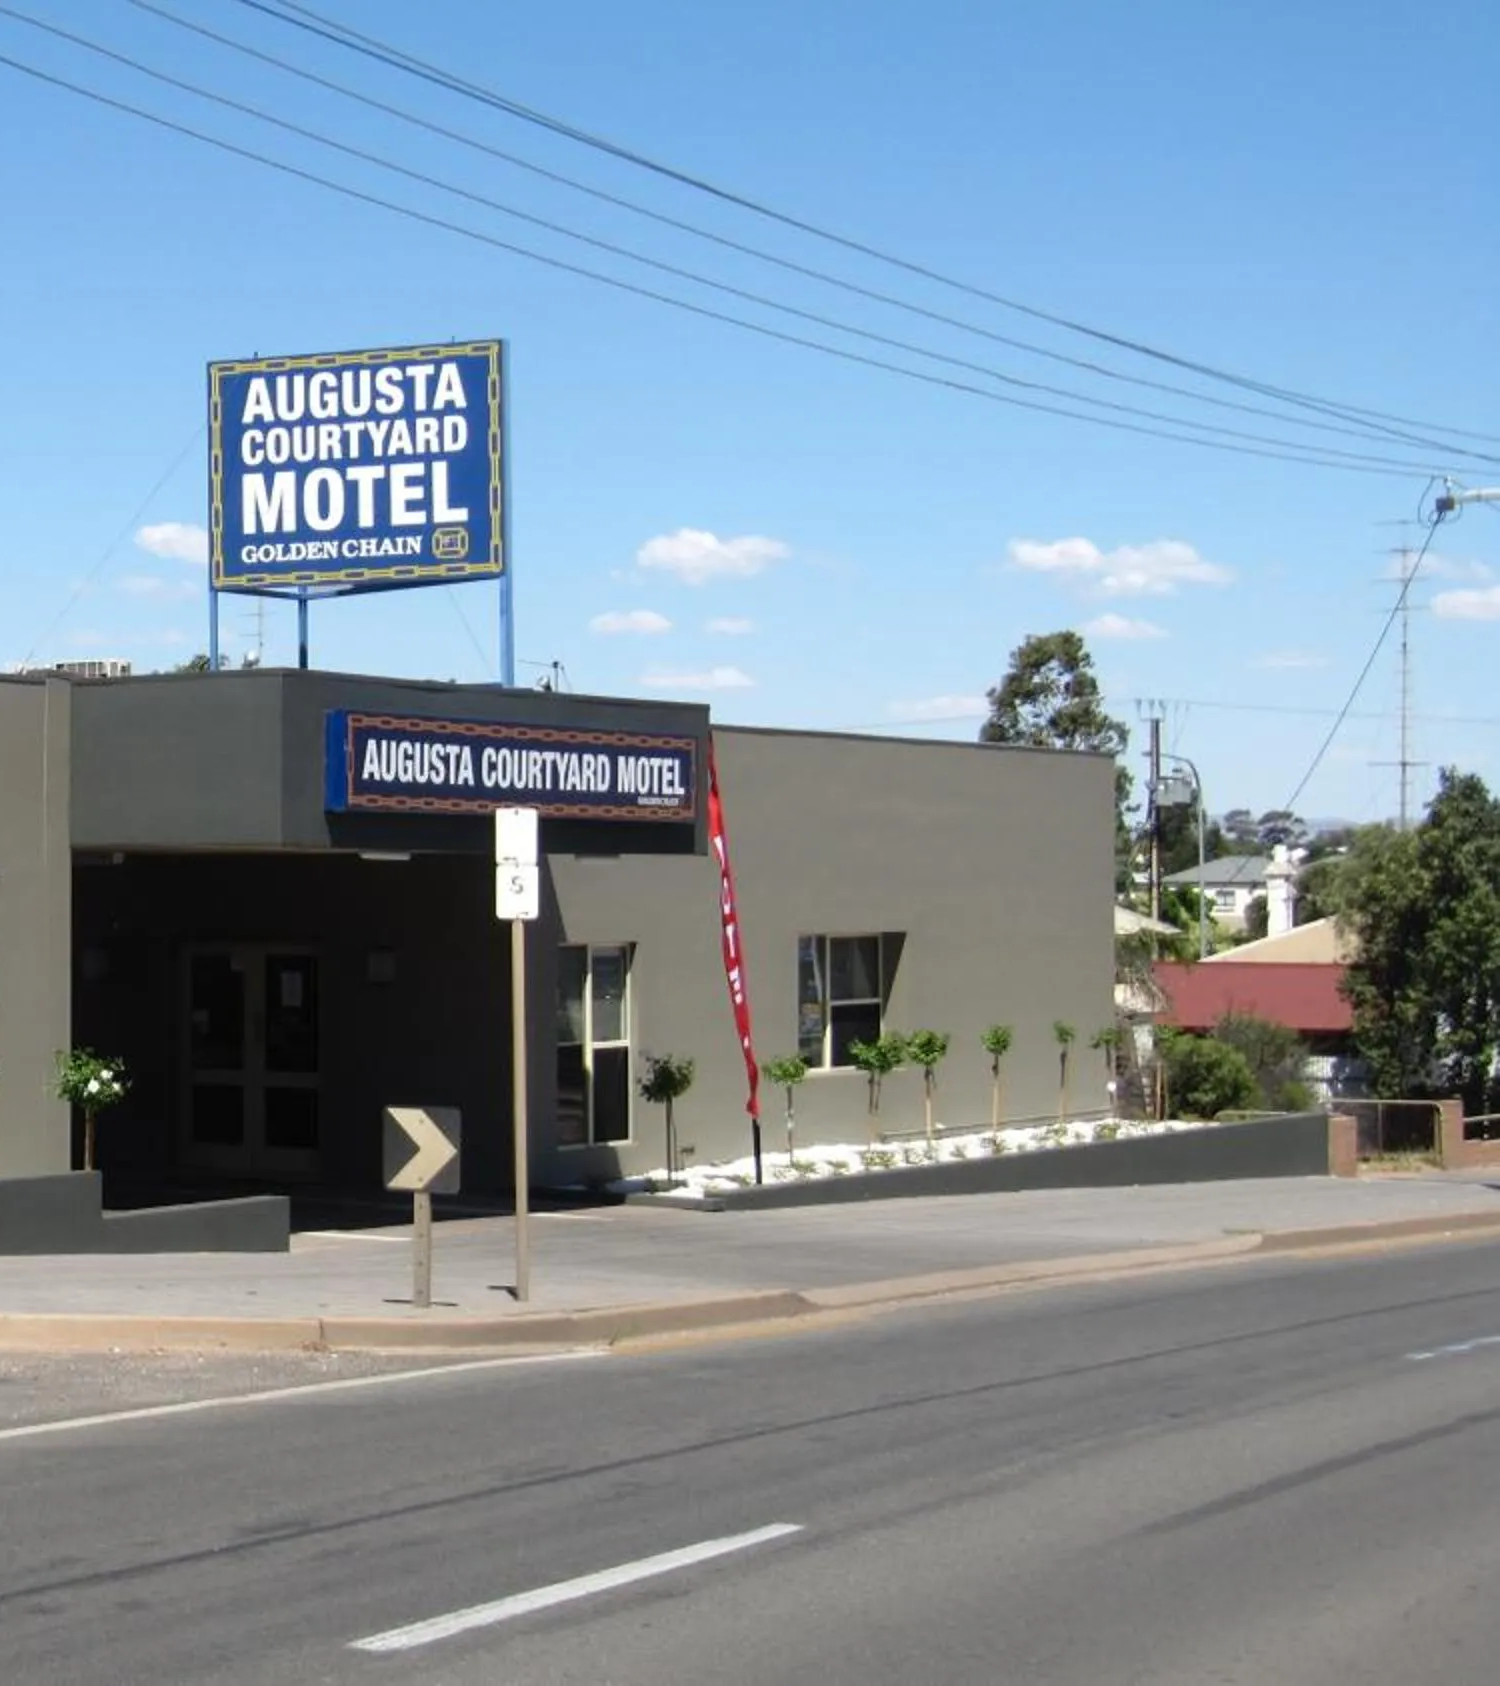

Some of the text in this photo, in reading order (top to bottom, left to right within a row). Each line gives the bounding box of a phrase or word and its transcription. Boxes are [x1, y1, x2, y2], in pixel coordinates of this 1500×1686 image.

[241, 362, 468, 424] AUGUSTA
[241, 415, 468, 466] COURTYARD
[241, 460, 469, 535] MOTEL
[241, 535, 423, 563] GOLDEN CHAIN
[362, 738, 685, 796] AUGUSTA COURTYARD MOTEL
